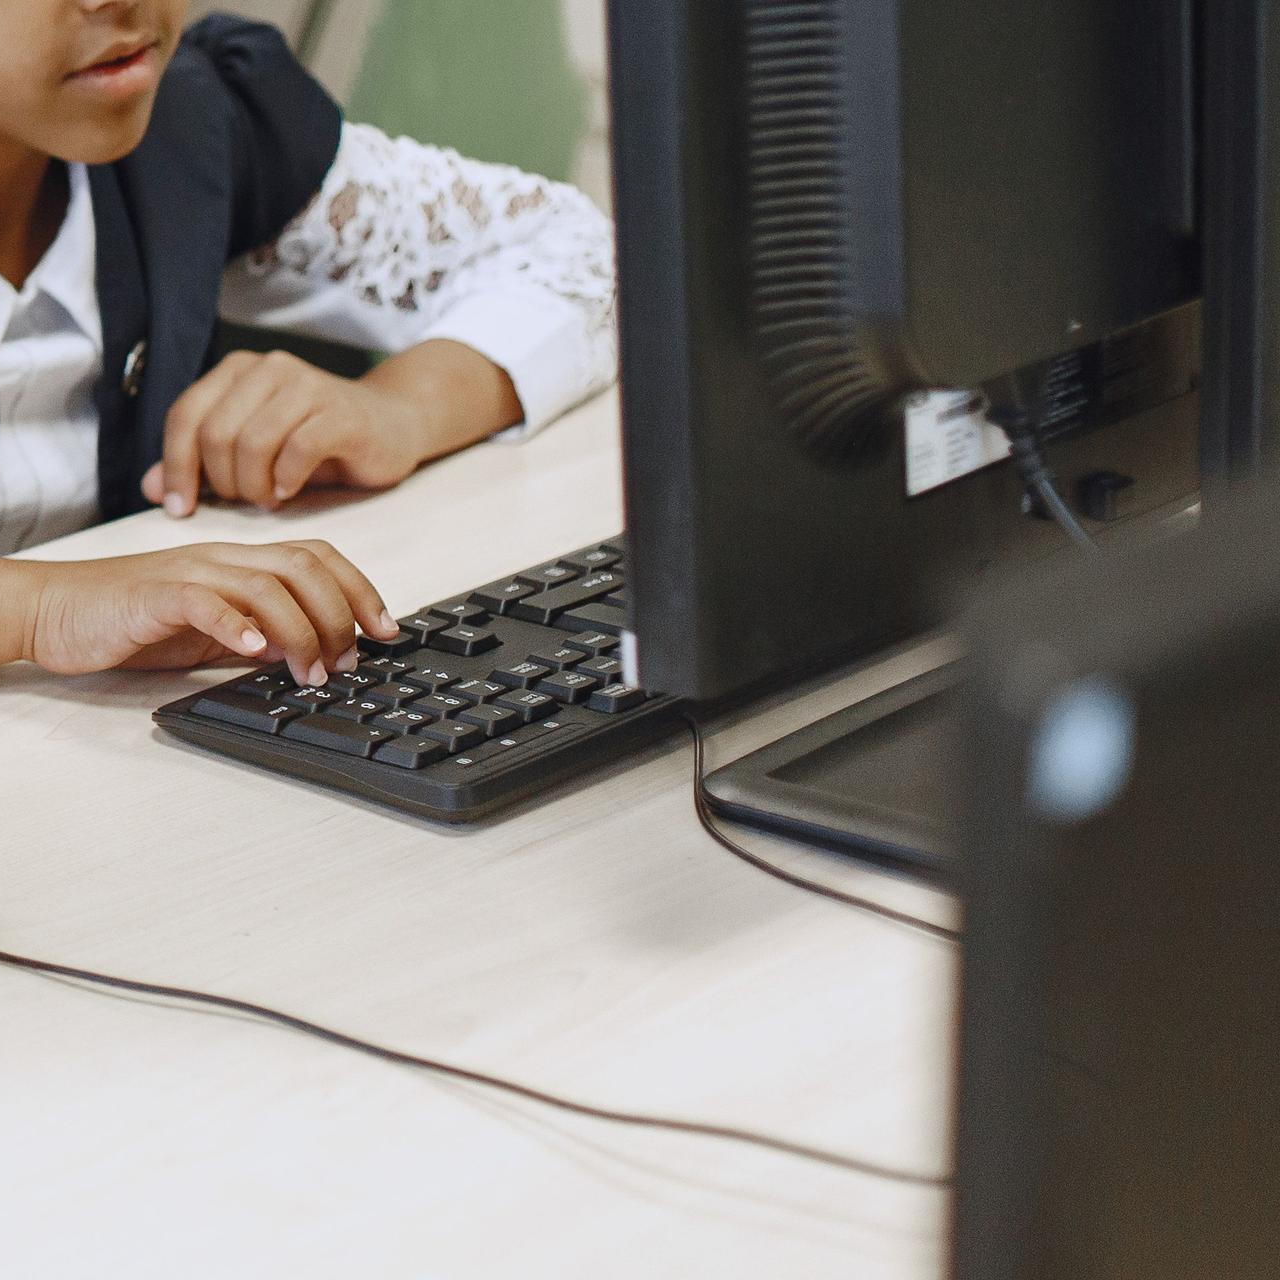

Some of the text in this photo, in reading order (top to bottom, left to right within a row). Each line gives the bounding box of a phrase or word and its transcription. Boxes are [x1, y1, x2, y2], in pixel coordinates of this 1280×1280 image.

[352, 675, 369, 684] 2
[435, 672, 450, 680] 4
[398, 686, 415, 694] 5
[484, 683, 500, 692] 7
[315, 690, 332, 699] 3
[360, 702, 376, 710] 6
[444, 698, 460, 706] 8
[407, 713, 423, 721] 9
